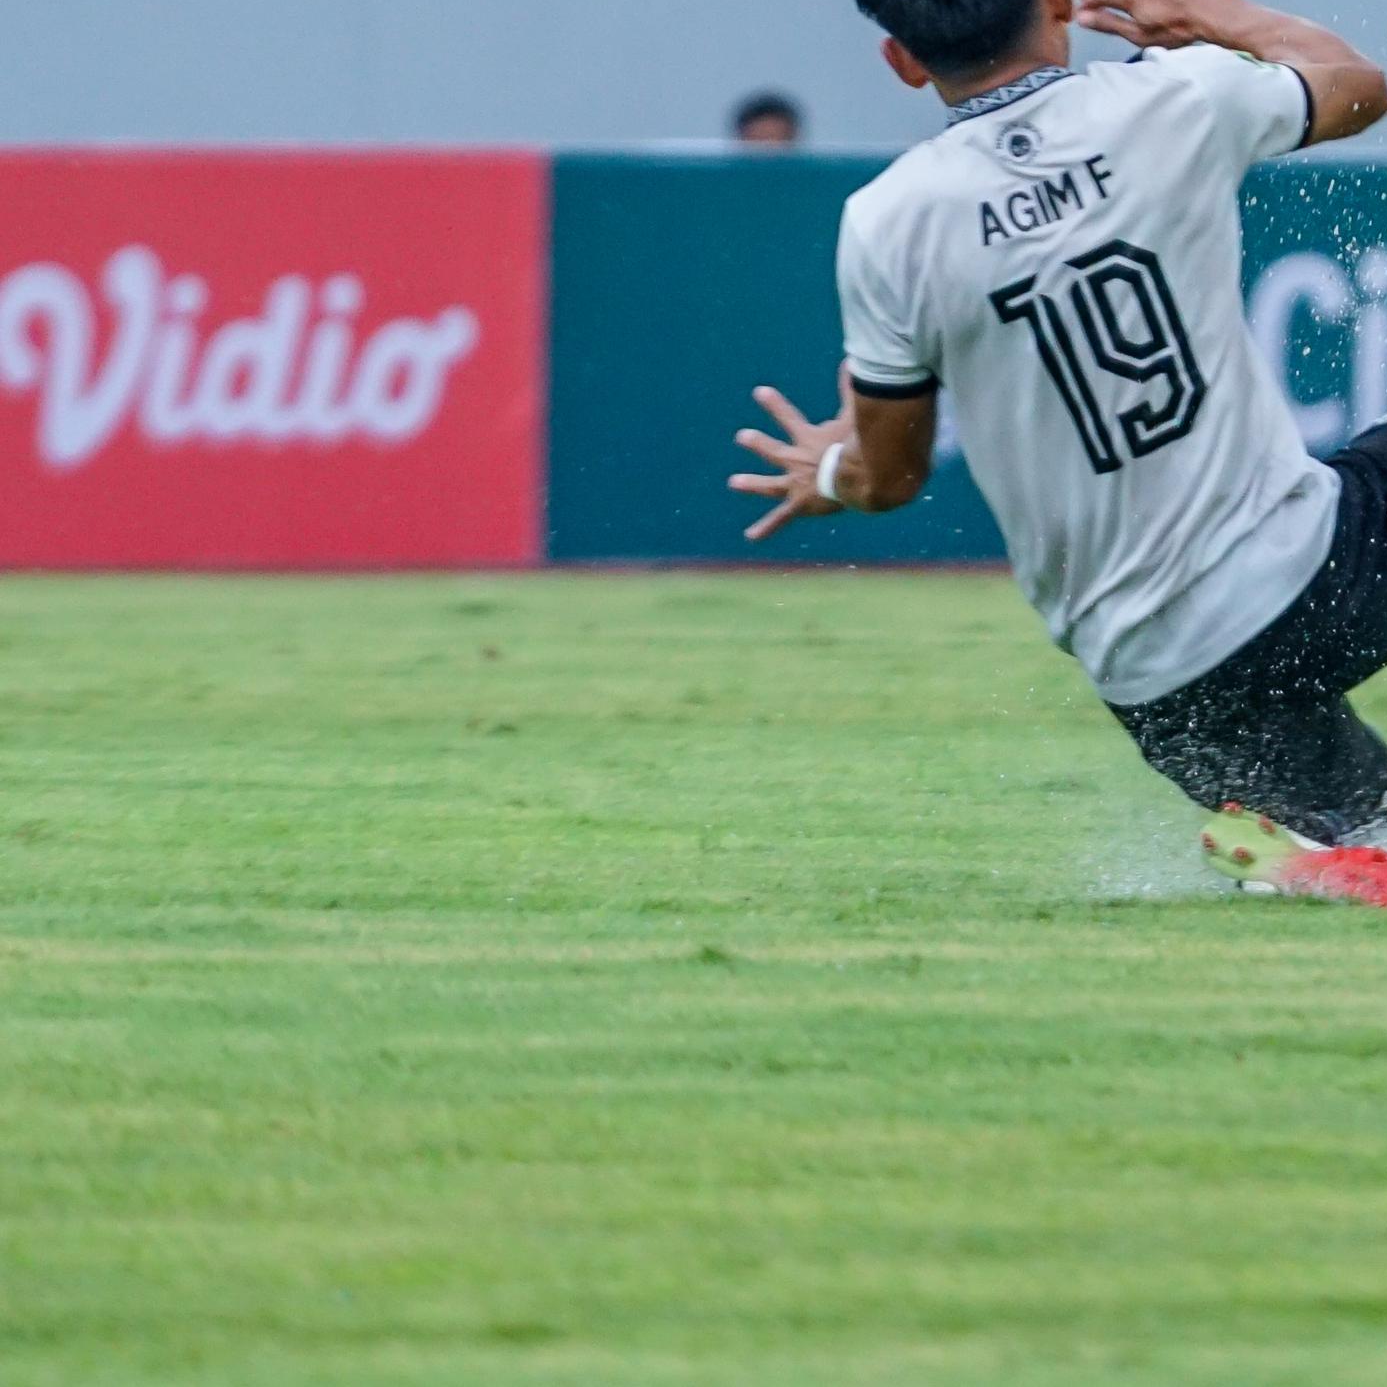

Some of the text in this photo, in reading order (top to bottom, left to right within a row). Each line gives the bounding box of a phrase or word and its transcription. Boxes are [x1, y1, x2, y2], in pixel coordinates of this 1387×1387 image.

[979, 154, 1113, 247] AGIM F
[0, 242, 481, 471] Vidio
[987, 237, 1210, 475] 19
